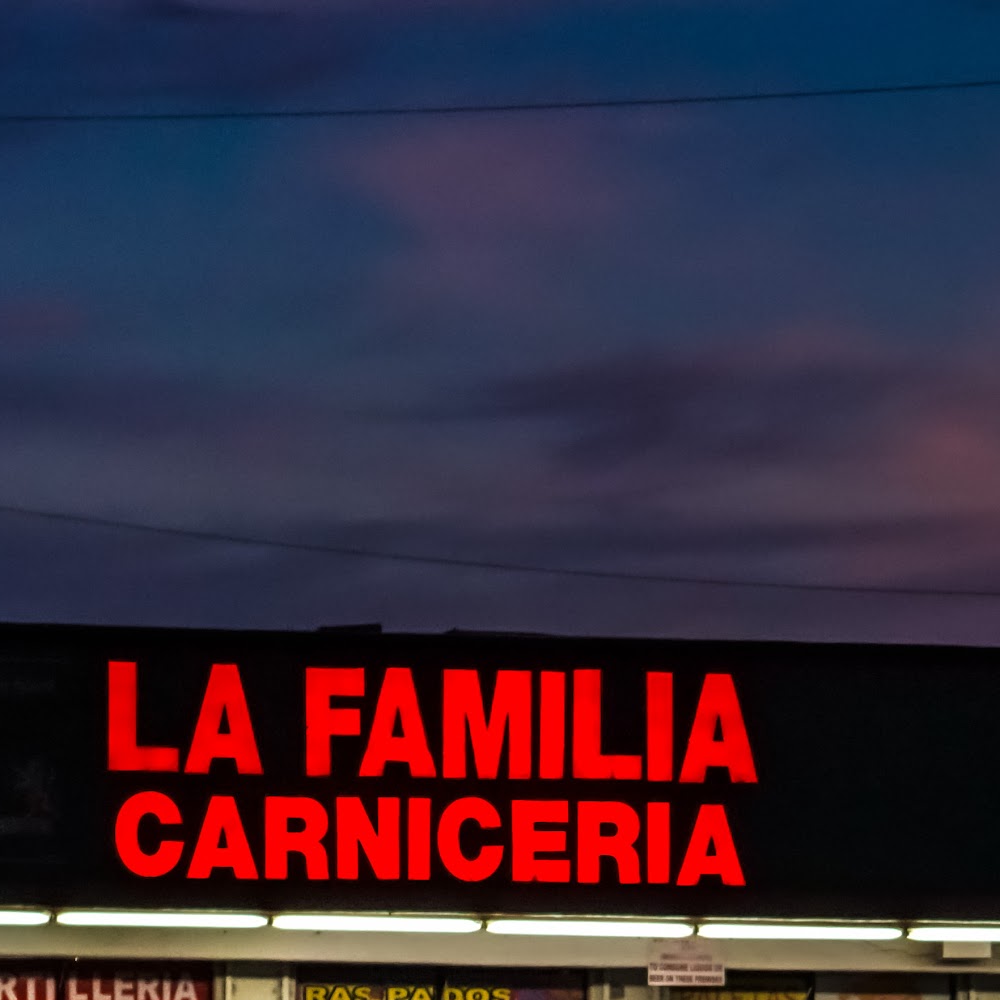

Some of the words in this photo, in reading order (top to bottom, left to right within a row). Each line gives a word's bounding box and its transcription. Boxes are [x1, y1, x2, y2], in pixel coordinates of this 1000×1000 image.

[108, 661, 262, 774] LA
[305, 667, 758, 783] FAMILIA
[115, 790, 747, 887] CARNICERIA
